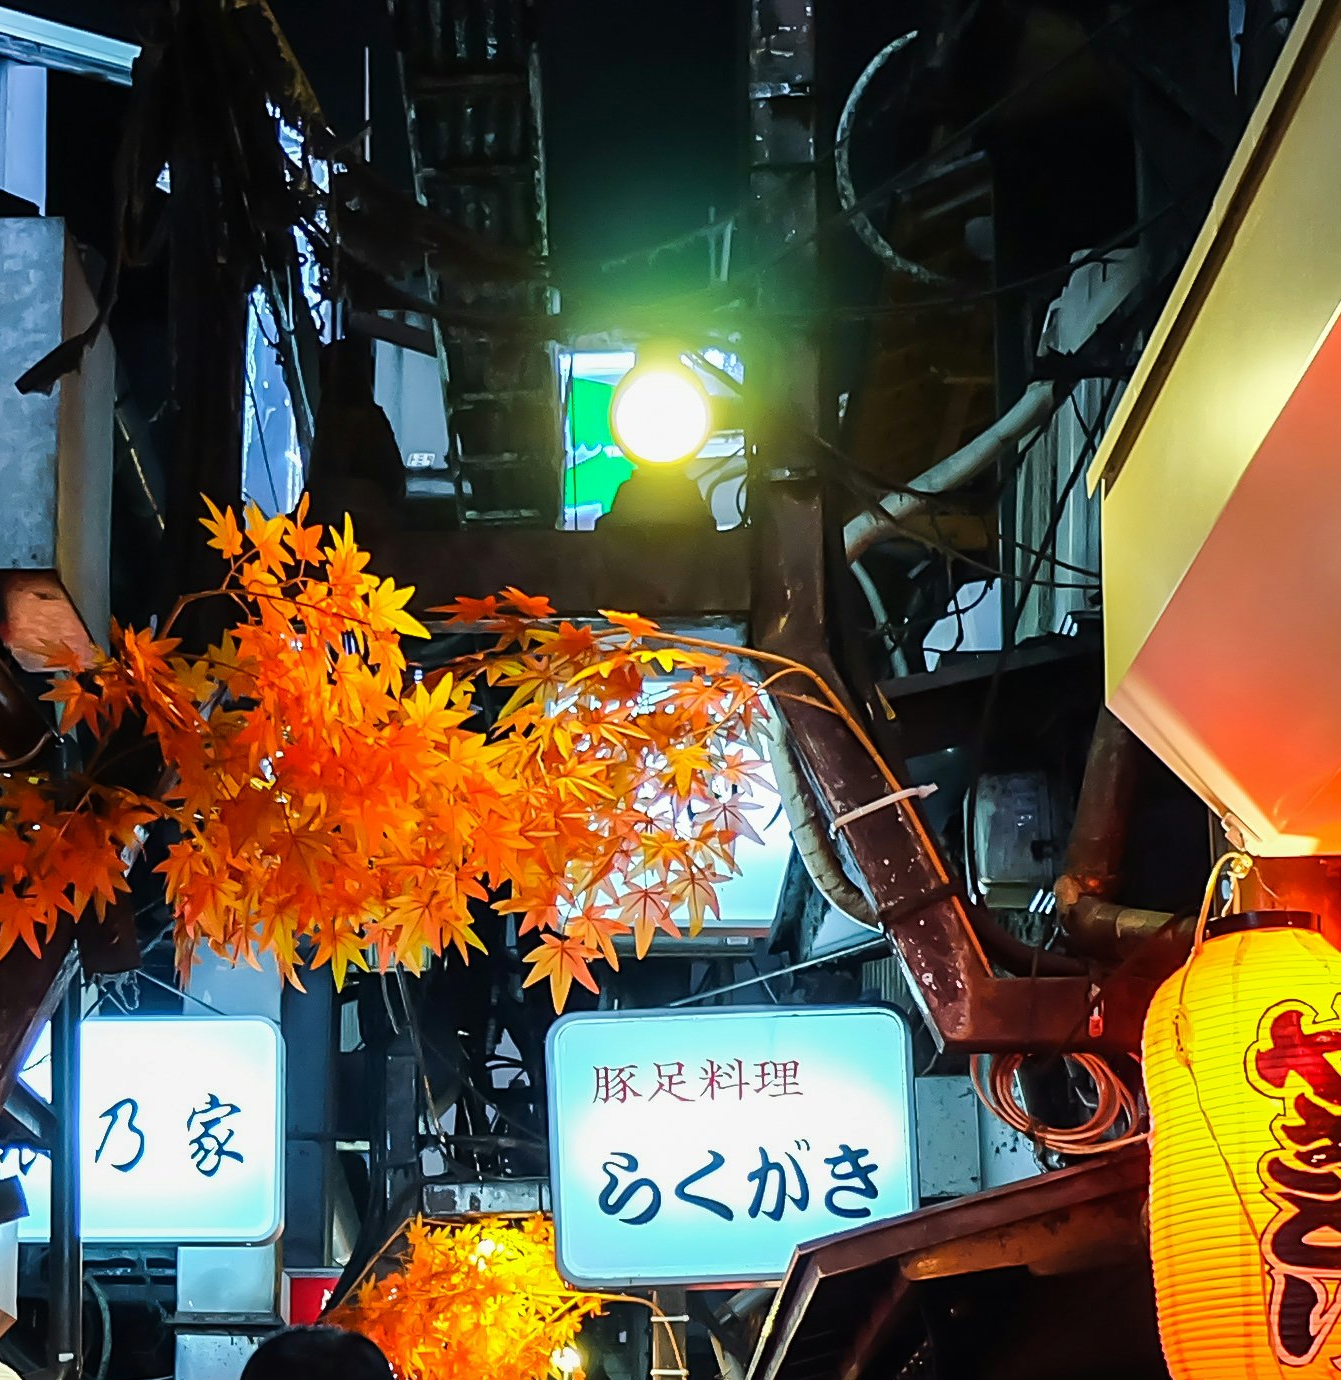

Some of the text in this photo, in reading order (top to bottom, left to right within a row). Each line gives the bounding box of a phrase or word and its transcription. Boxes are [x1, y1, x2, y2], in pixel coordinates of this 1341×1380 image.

[592, 1057, 805, 1104] 豚足料理
[598, 1136, 880, 1226] らくがき
